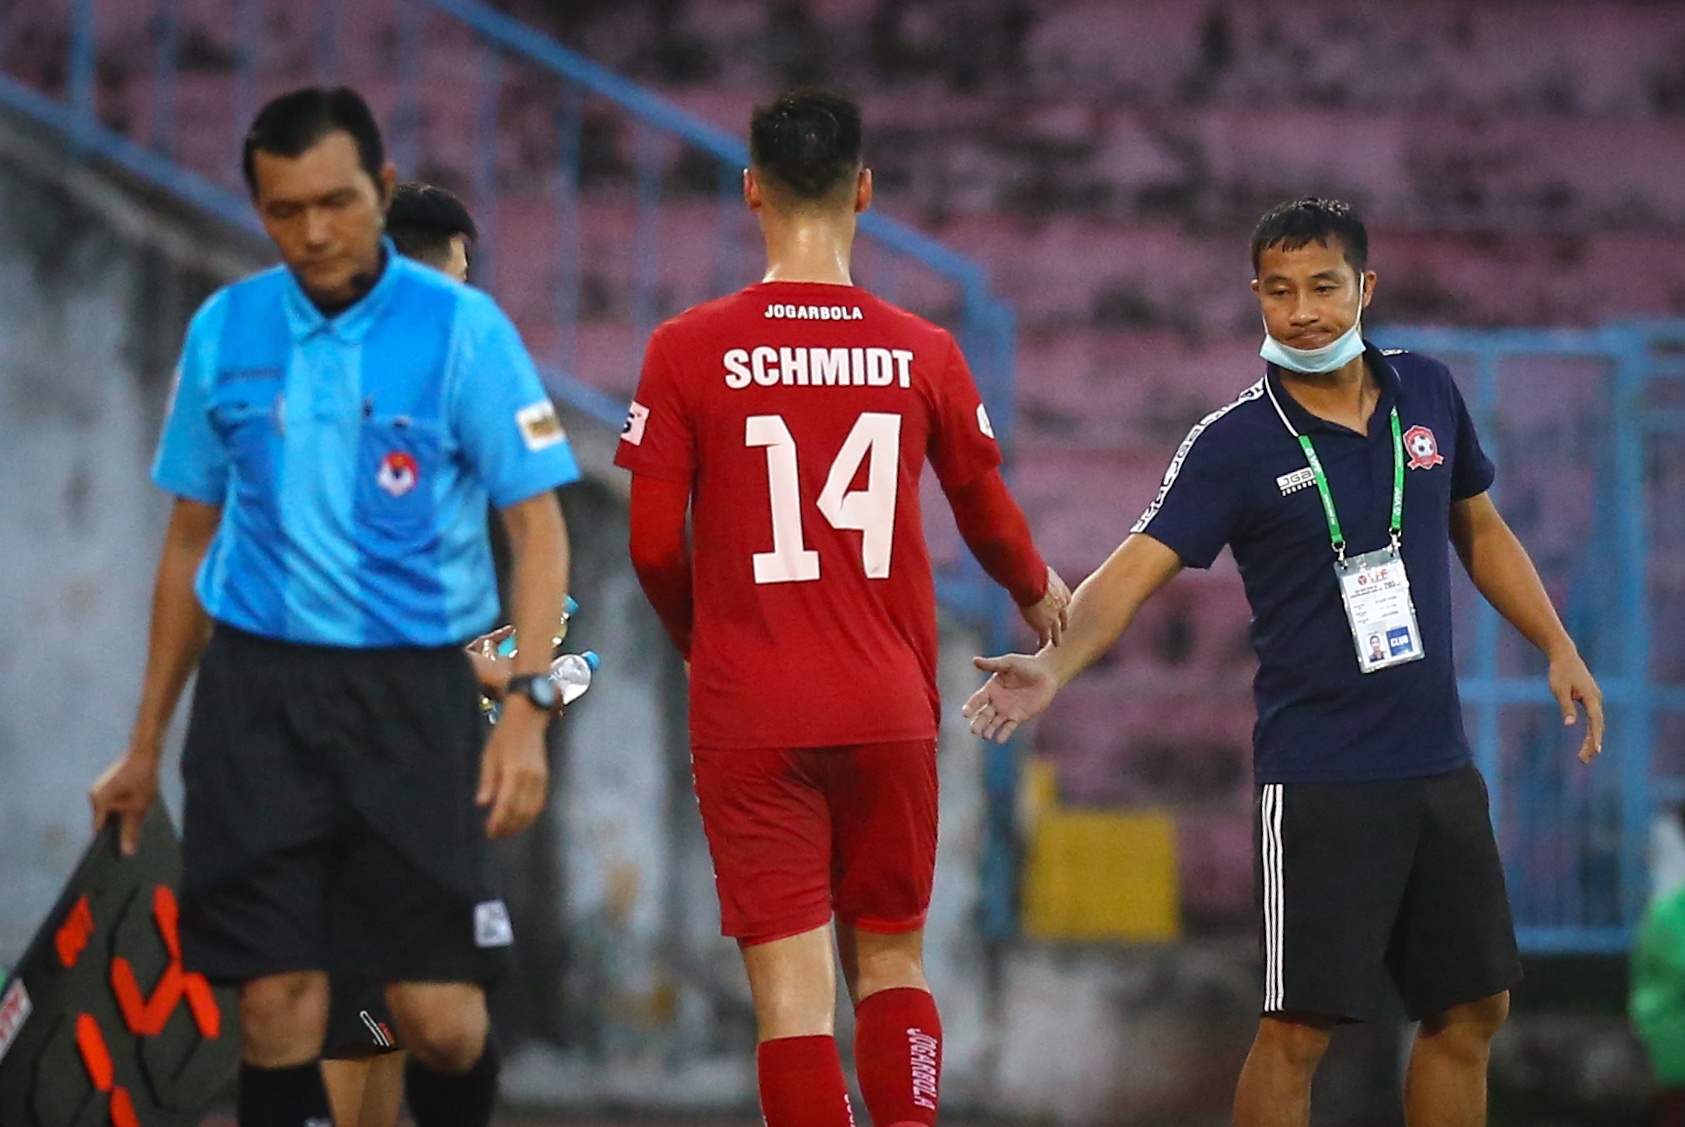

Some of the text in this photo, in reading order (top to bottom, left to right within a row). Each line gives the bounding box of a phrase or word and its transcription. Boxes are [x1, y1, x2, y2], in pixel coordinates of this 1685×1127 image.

[764, 303, 863, 321] JOGARBOLA
[723, 345, 914, 389] SCHMIDT
[744, 411, 902, 584] 14
[906, 1026, 939, 1111] JOGARBOLA
